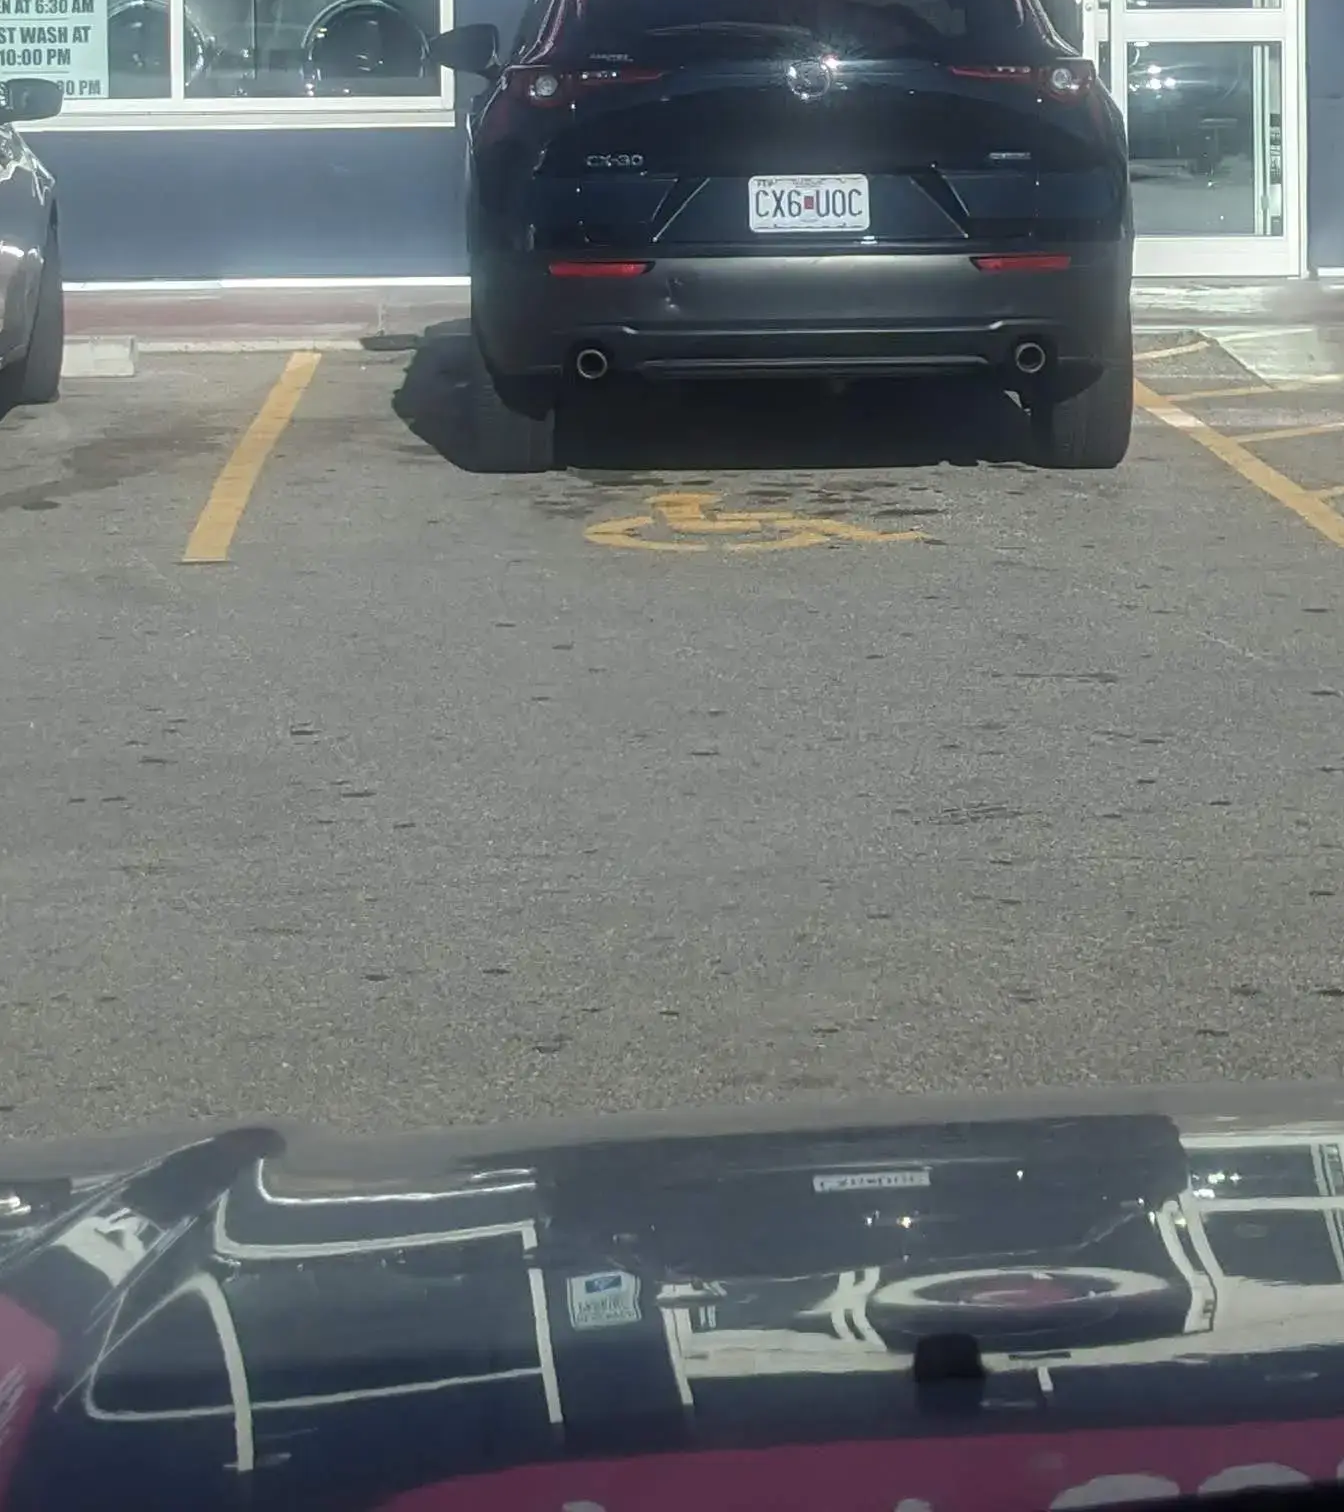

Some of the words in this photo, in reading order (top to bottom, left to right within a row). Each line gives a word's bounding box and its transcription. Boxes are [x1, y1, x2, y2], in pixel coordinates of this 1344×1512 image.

[14, 0, 32, 14] AT
[19, 26, 69, 44] WASH
[72, 26, 91, 43] AT
[46, 48, 71, 65] PM
[78, 80, 101, 95] PM
